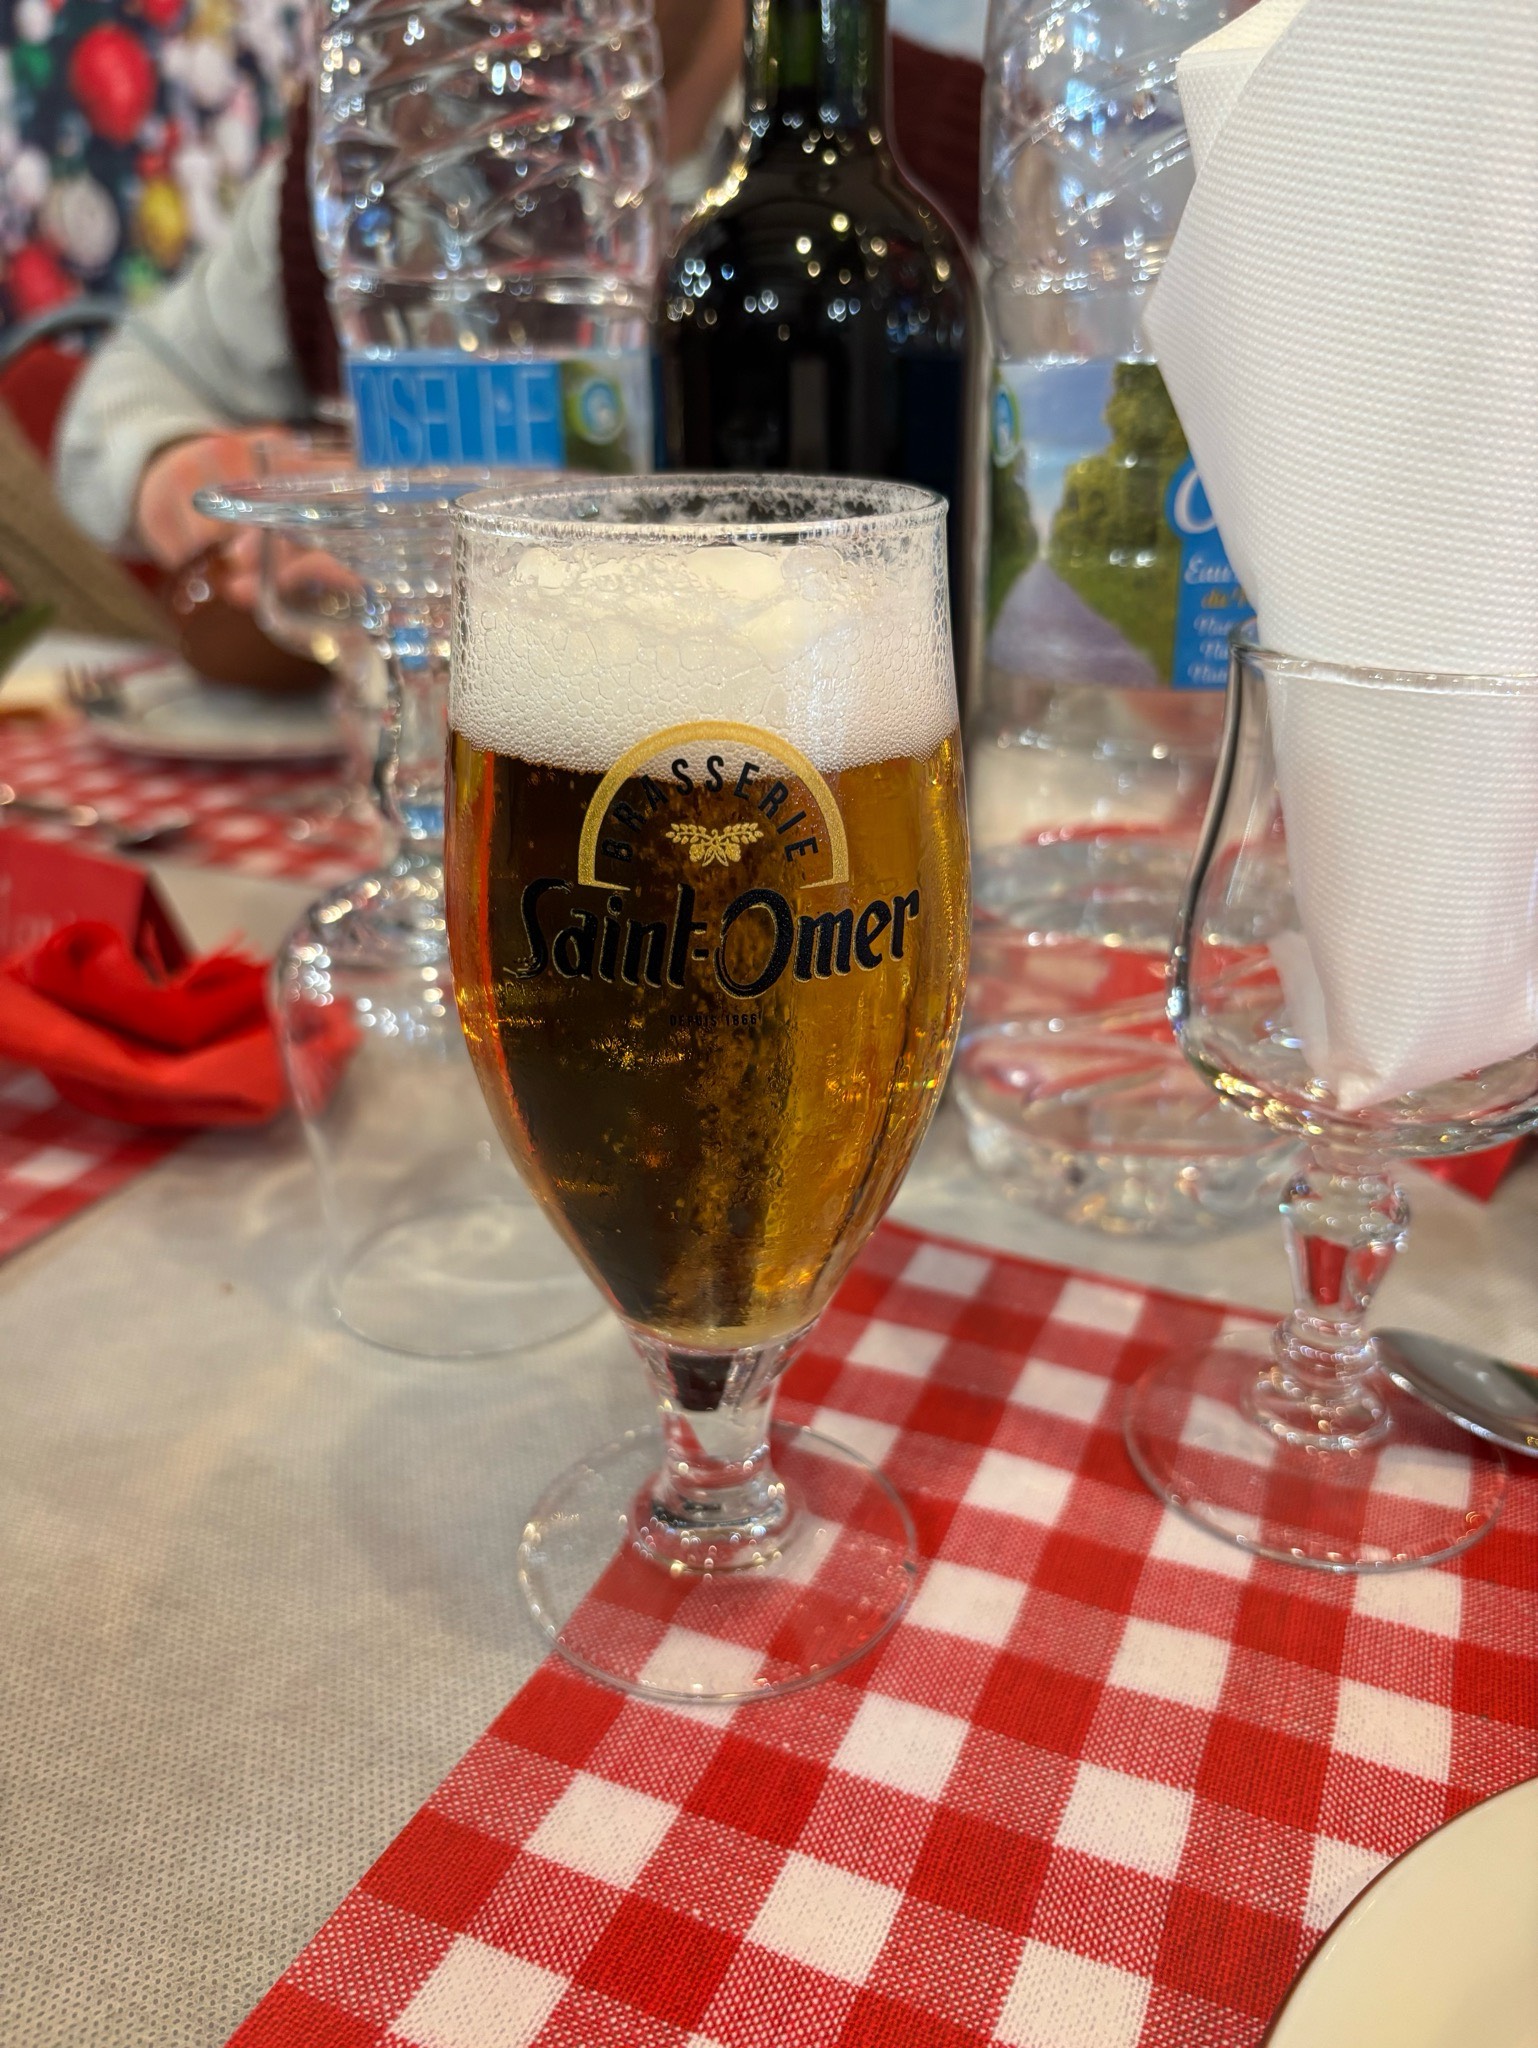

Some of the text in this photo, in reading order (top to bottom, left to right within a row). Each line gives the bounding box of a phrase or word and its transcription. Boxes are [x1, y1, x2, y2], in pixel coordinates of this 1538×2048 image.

[601, 755, 819, 863] BRASSERIE
[503, 877, 920, 1000] Saint-Omer
[669, 1013, 758, 1027] DEPUIS 1866
